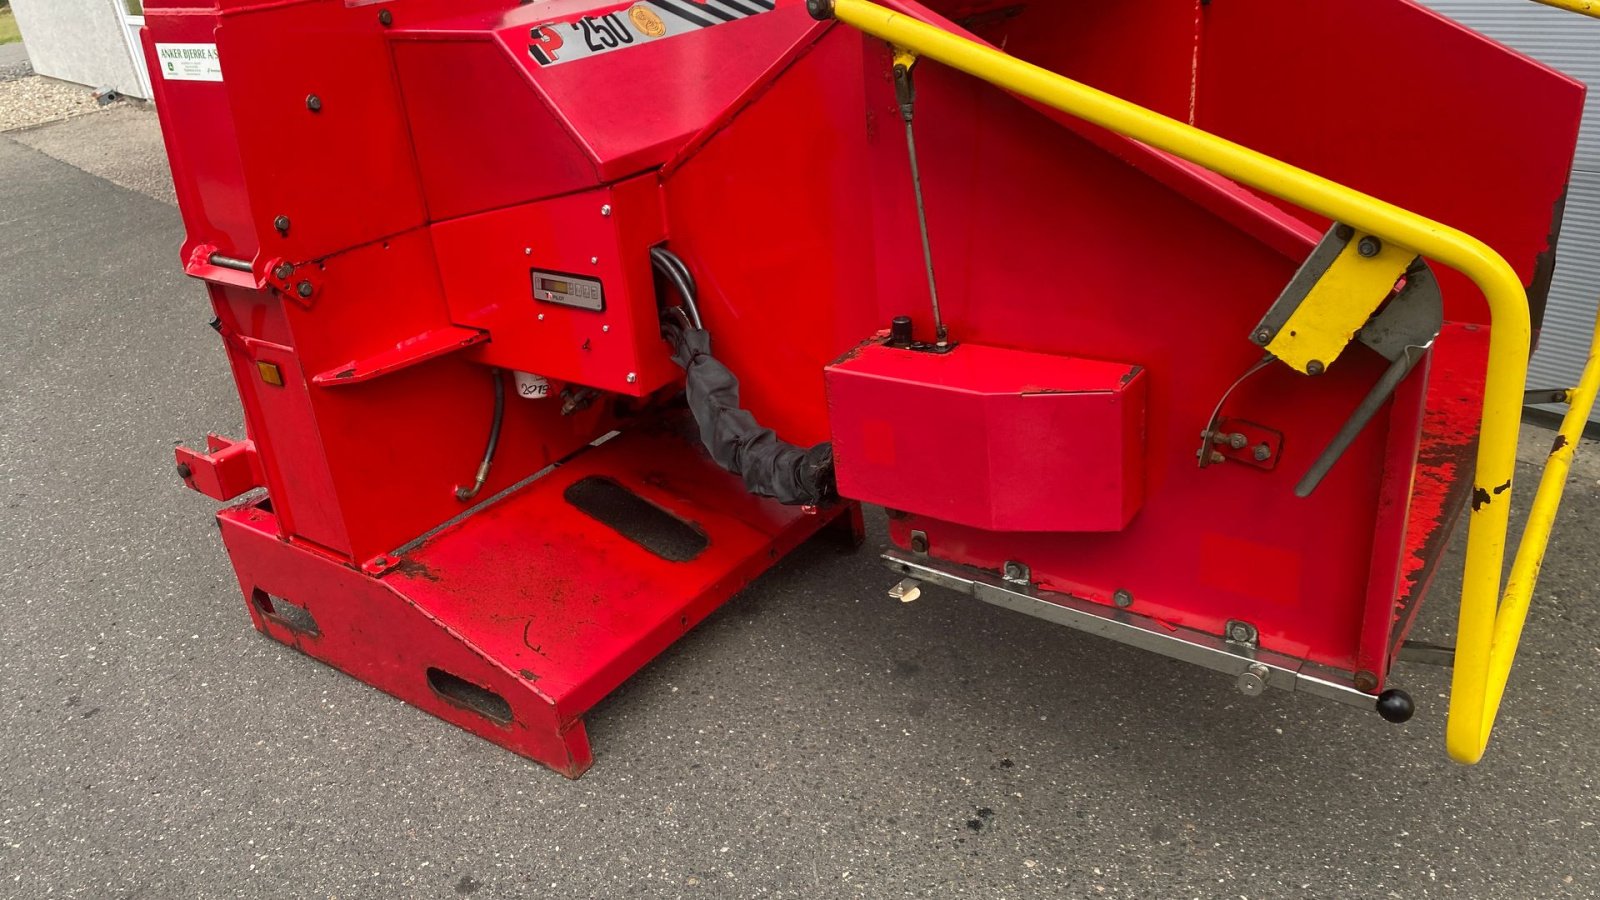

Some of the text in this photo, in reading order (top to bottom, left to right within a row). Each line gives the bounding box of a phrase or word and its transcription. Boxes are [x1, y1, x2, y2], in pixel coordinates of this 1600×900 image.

[572, 14, 634, 52] 250
[160, 48, 183, 59] ANKER
[183, 49, 207, 60] BJERRE
